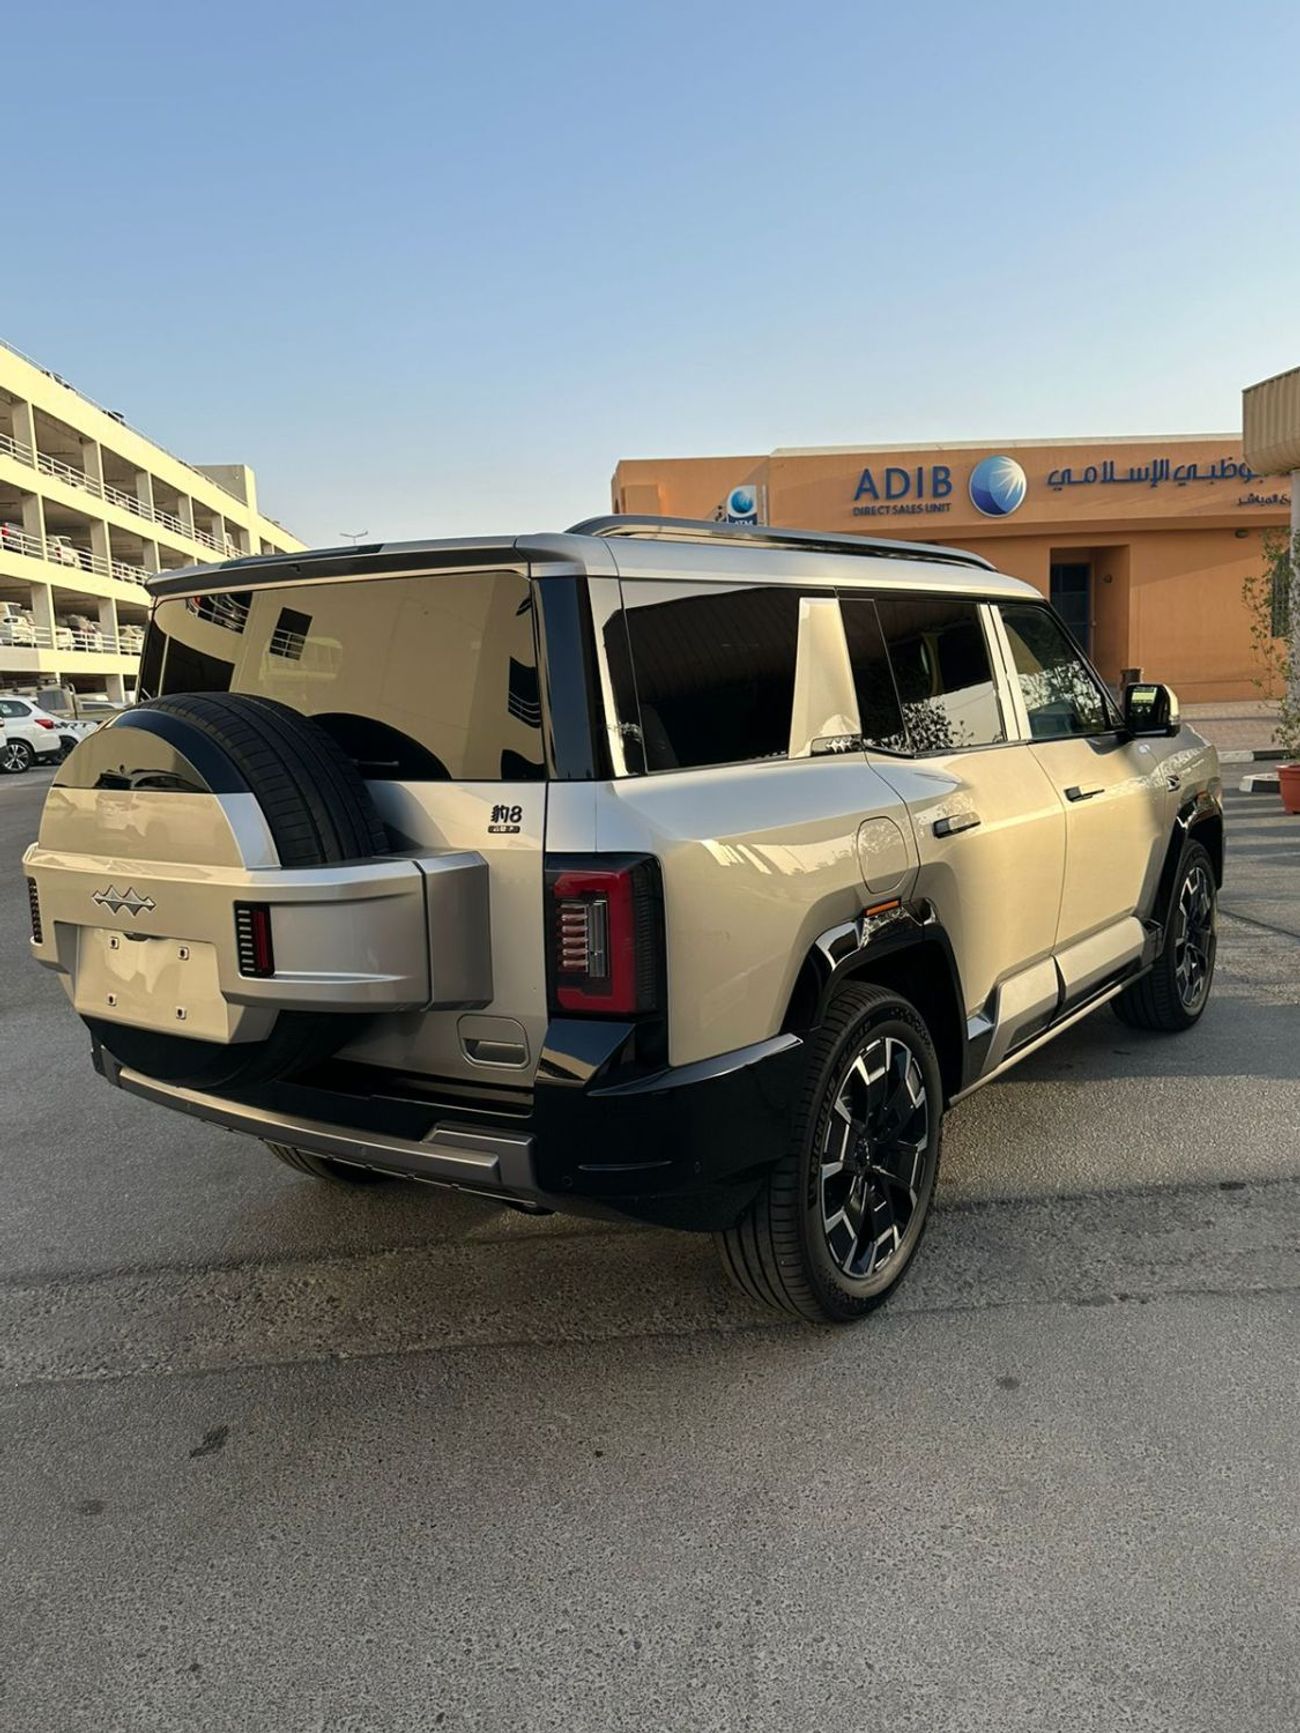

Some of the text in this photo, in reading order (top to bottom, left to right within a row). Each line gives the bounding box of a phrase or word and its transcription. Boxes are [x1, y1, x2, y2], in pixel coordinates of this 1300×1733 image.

[853, 466, 953, 501] ADIB
[1047, 458, 1169, 491] الإسلامي
[852, 502, 952, 517] DIRECT SALES UNIT
